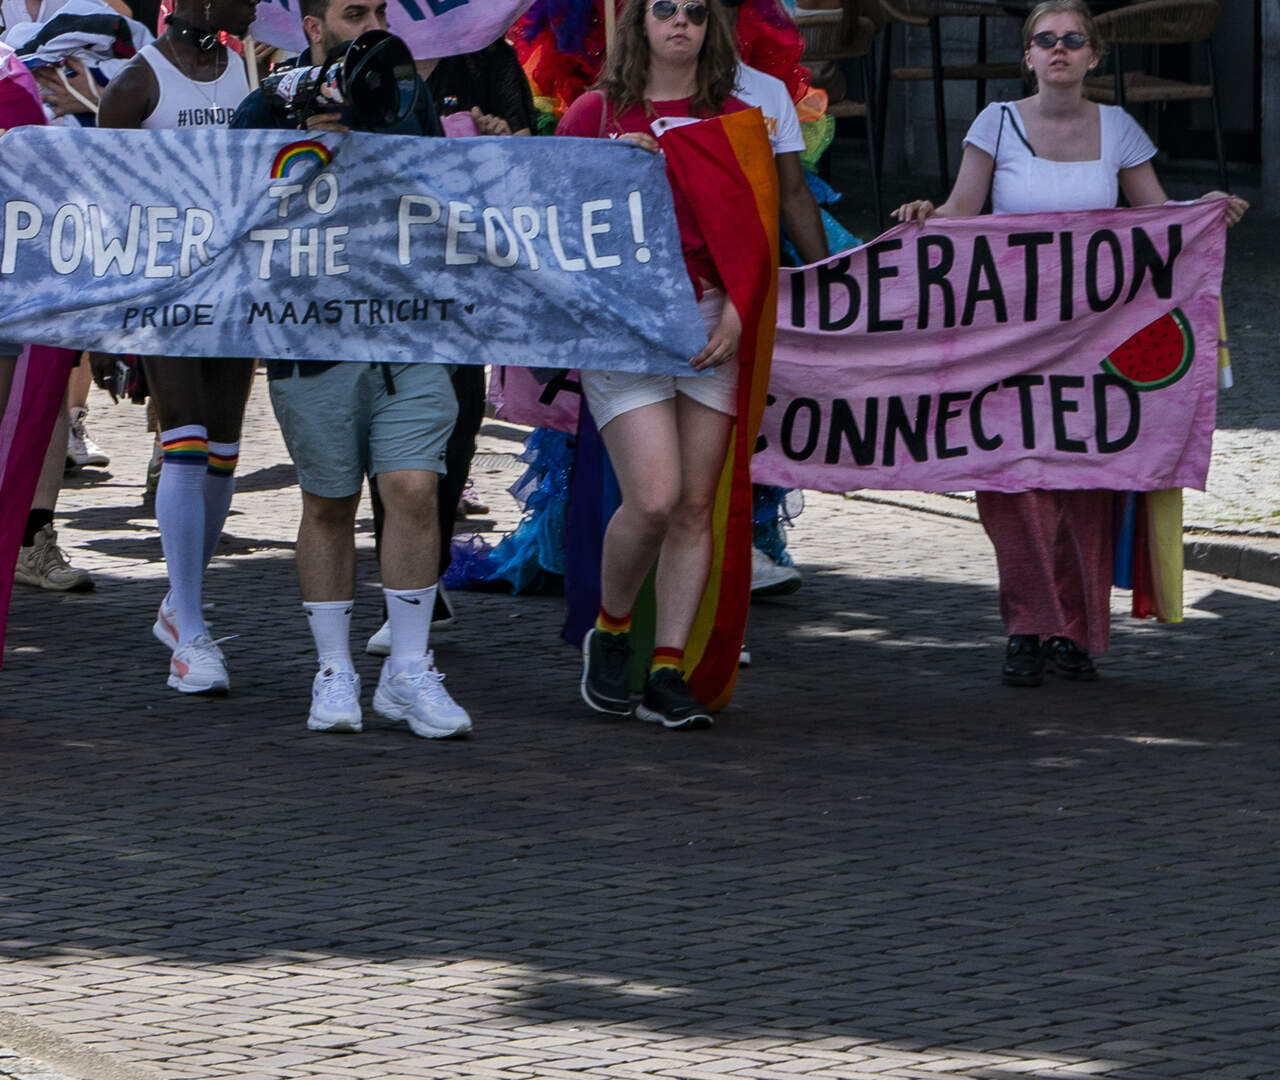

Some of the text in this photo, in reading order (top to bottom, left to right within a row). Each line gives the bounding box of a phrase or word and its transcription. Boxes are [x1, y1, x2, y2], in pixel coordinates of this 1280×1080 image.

[0, 173, 652, 279] POWER TO THE PEOPLE!
[790, 224, 1183, 333] IBERATION
[122, 298, 456, 328] PRIDE MAASTRICHT
